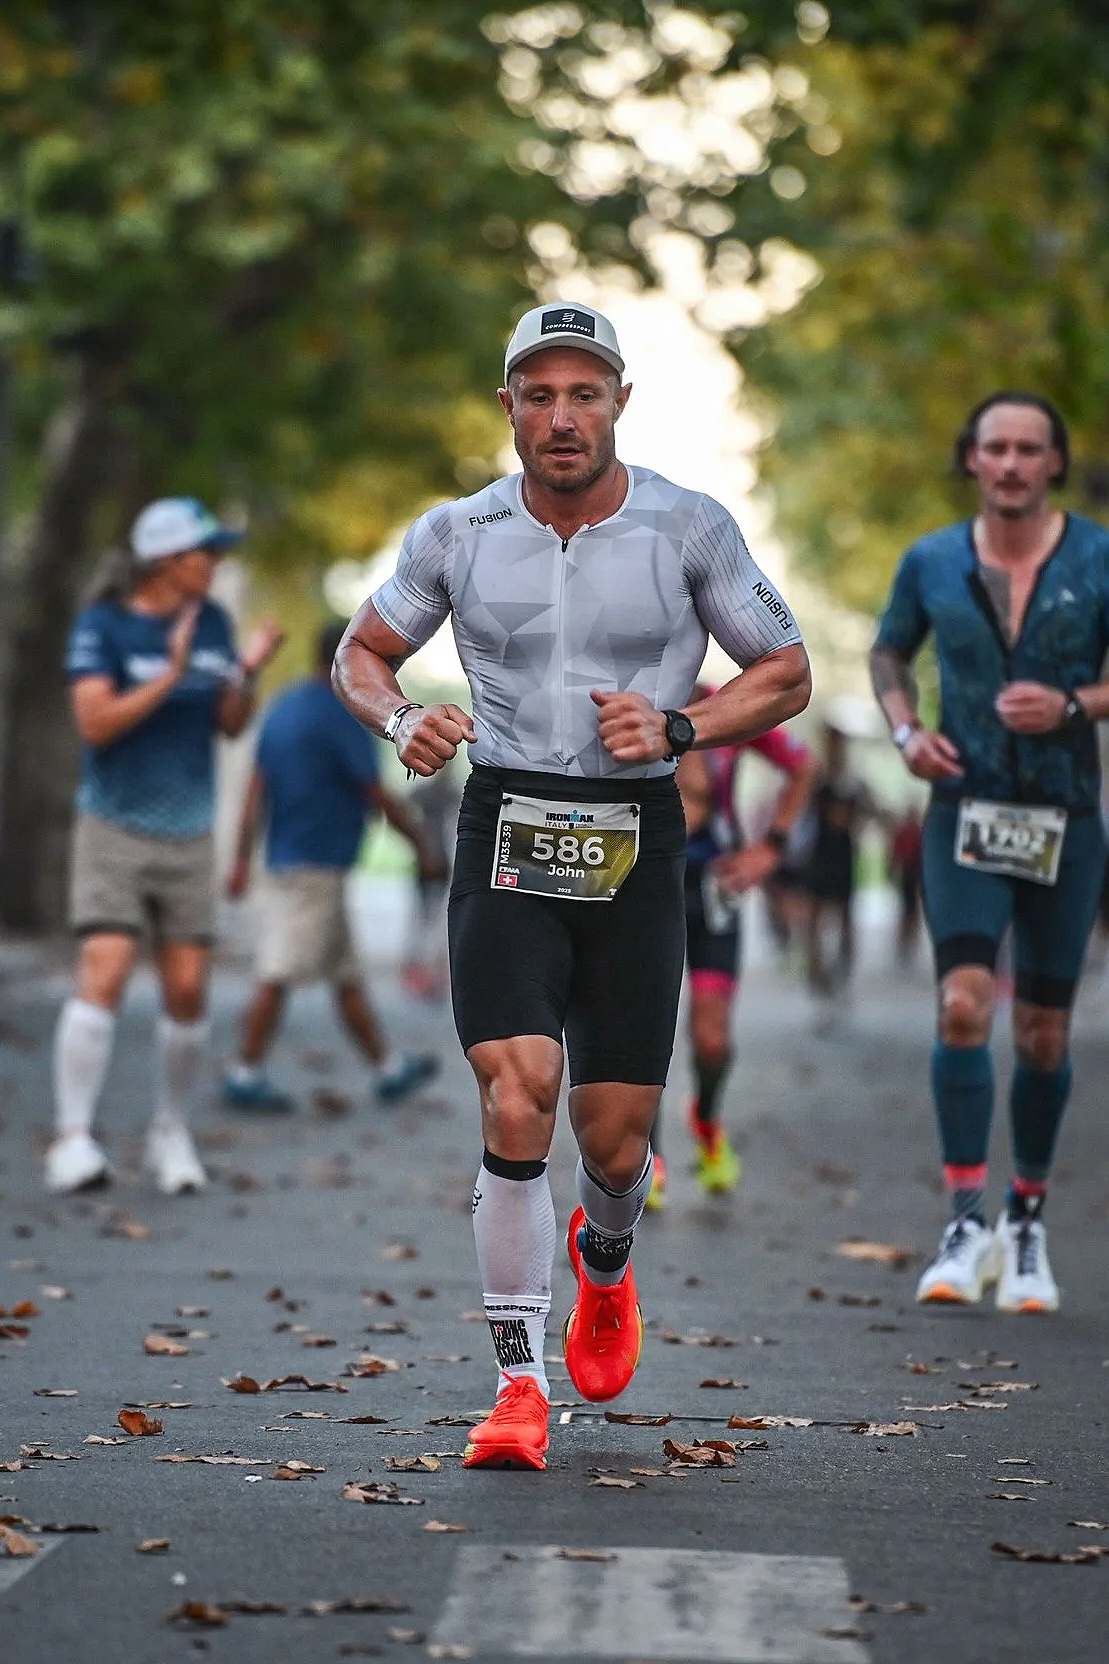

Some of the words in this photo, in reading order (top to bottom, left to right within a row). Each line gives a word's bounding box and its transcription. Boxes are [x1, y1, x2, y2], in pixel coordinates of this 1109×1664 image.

[469, 508, 513, 526] FUSION
[752, 581, 792, 630] FUSION
[546, 810, 594, 823] IRONMAN
[500, 824, 512, 864] M35-39
[531, 832, 605, 866] 586
[547, 864, 585, 879] John
